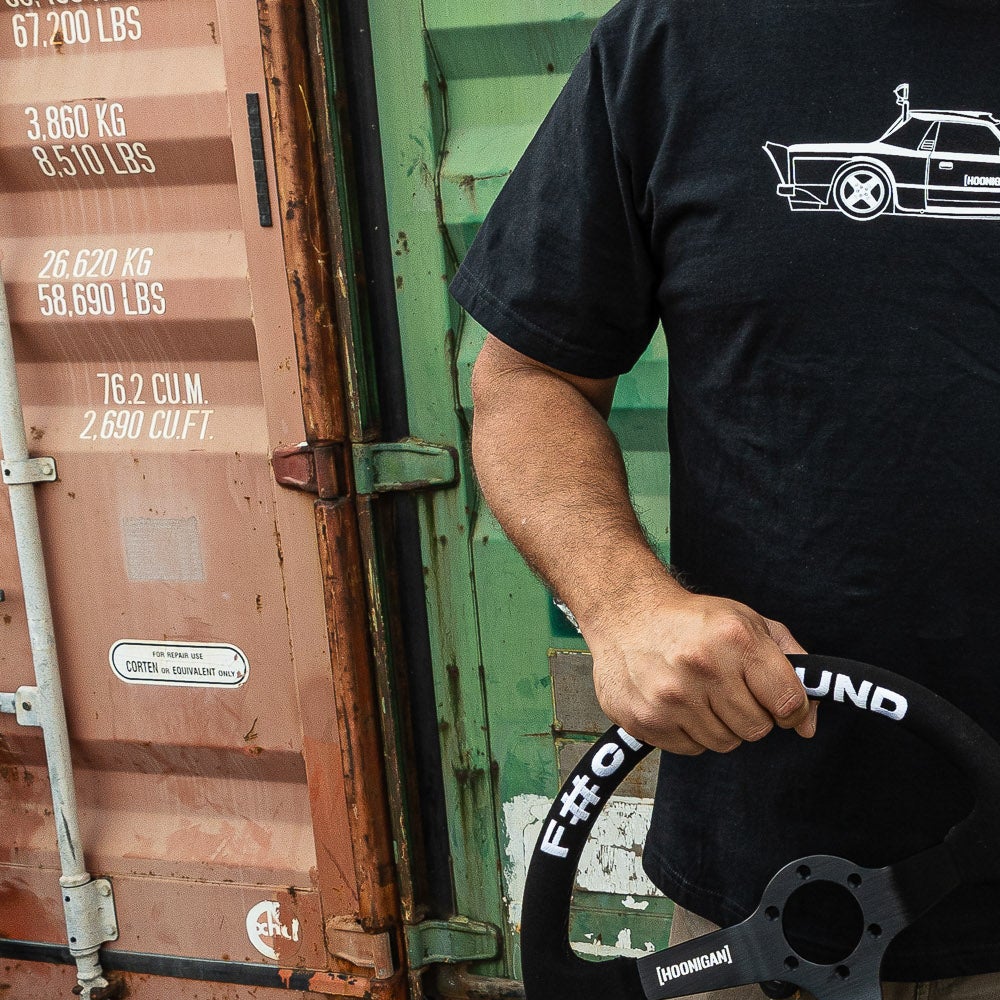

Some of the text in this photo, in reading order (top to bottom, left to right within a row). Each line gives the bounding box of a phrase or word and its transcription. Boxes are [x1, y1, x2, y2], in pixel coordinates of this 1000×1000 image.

[96, 5, 142, 43] LBS
[24, 102, 127, 141] 3,860 KG
[31, 141, 156, 178] 8,510 LBS
[37, 246, 155, 280] 26,620 KG
[37, 281, 167, 318] 58,690 LBS
[96, 372, 146, 405] 76.2
[79, 409, 145, 441] 2,690
[125, 660, 159, 674] CORTEN
[172, 666, 216, 677] EQUIVALENT
[218, 669, 236, 678] ONLY
[152, 650, 204, 661] FOR REPAIR USE
[794, 665, 909, 721] UND
[655, 944, 733, 987] [HOONIGAN]
